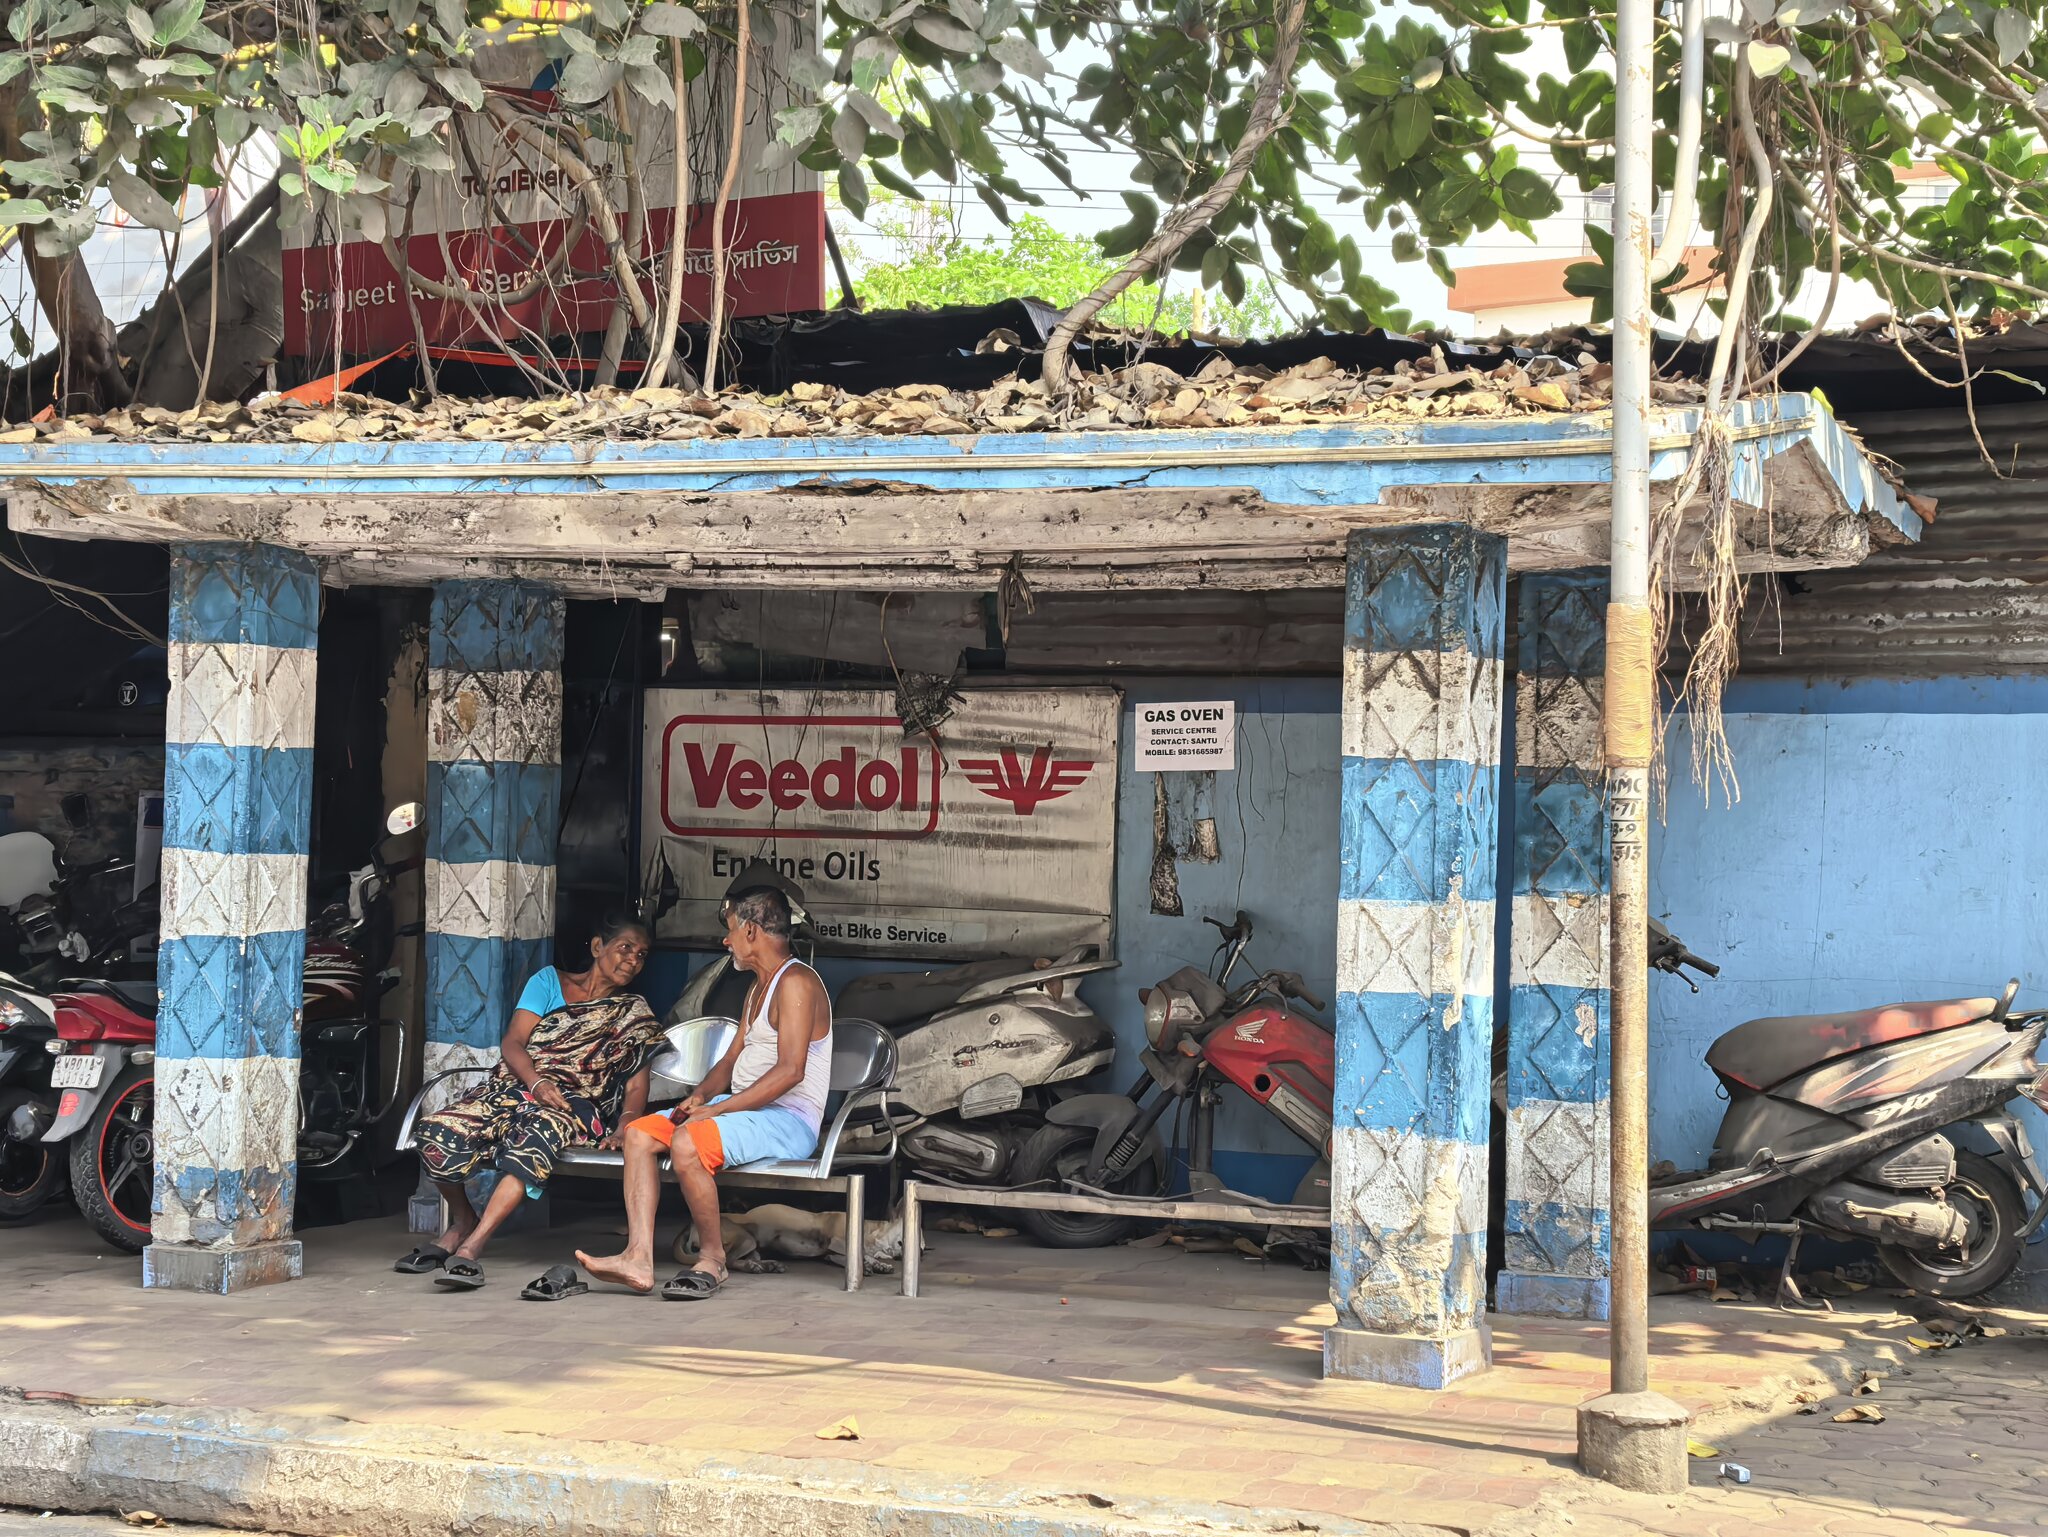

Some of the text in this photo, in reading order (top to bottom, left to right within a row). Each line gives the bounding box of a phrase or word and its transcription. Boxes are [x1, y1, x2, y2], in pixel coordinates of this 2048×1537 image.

[1144, 708, 1224, 722] GAS OVEN
[683, 743, 918, 812] Veedol
[712, 850, 815, 879] Enine
[824, 851, 881, 881] Oils
[847, 923, 882, 940] Bike
[887, 925, 947, 943] Service
[1234, 1035, 1265, 1045] HONDA
